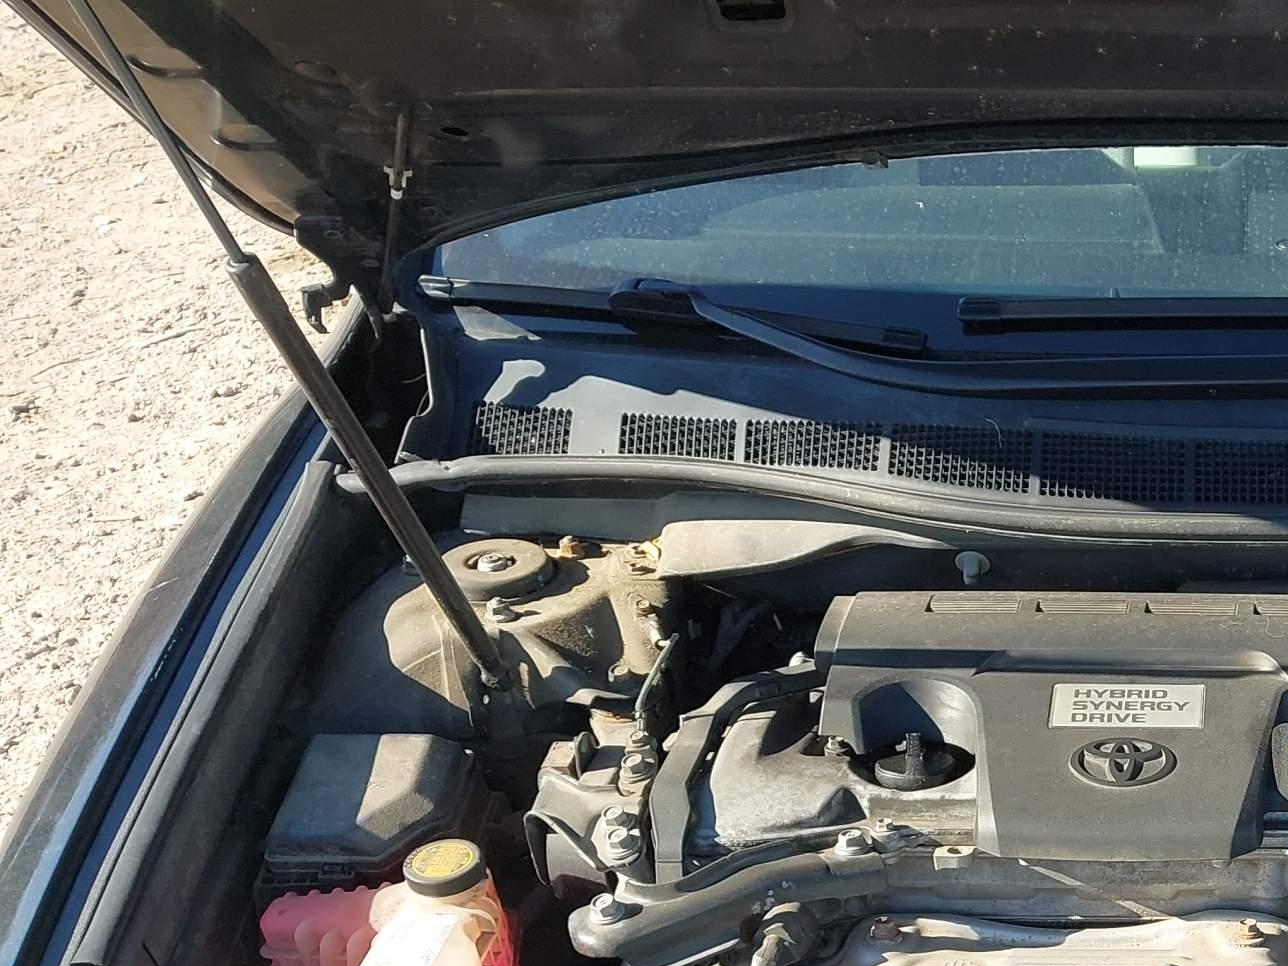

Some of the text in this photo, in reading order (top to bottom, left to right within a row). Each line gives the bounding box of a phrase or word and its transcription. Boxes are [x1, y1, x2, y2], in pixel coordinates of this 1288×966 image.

[1074, 689, 1168, 699] HYBRID
[1072, 701, 1190, 711] SYNERGY
[1071, 713, 1147, 723] DRIVE
